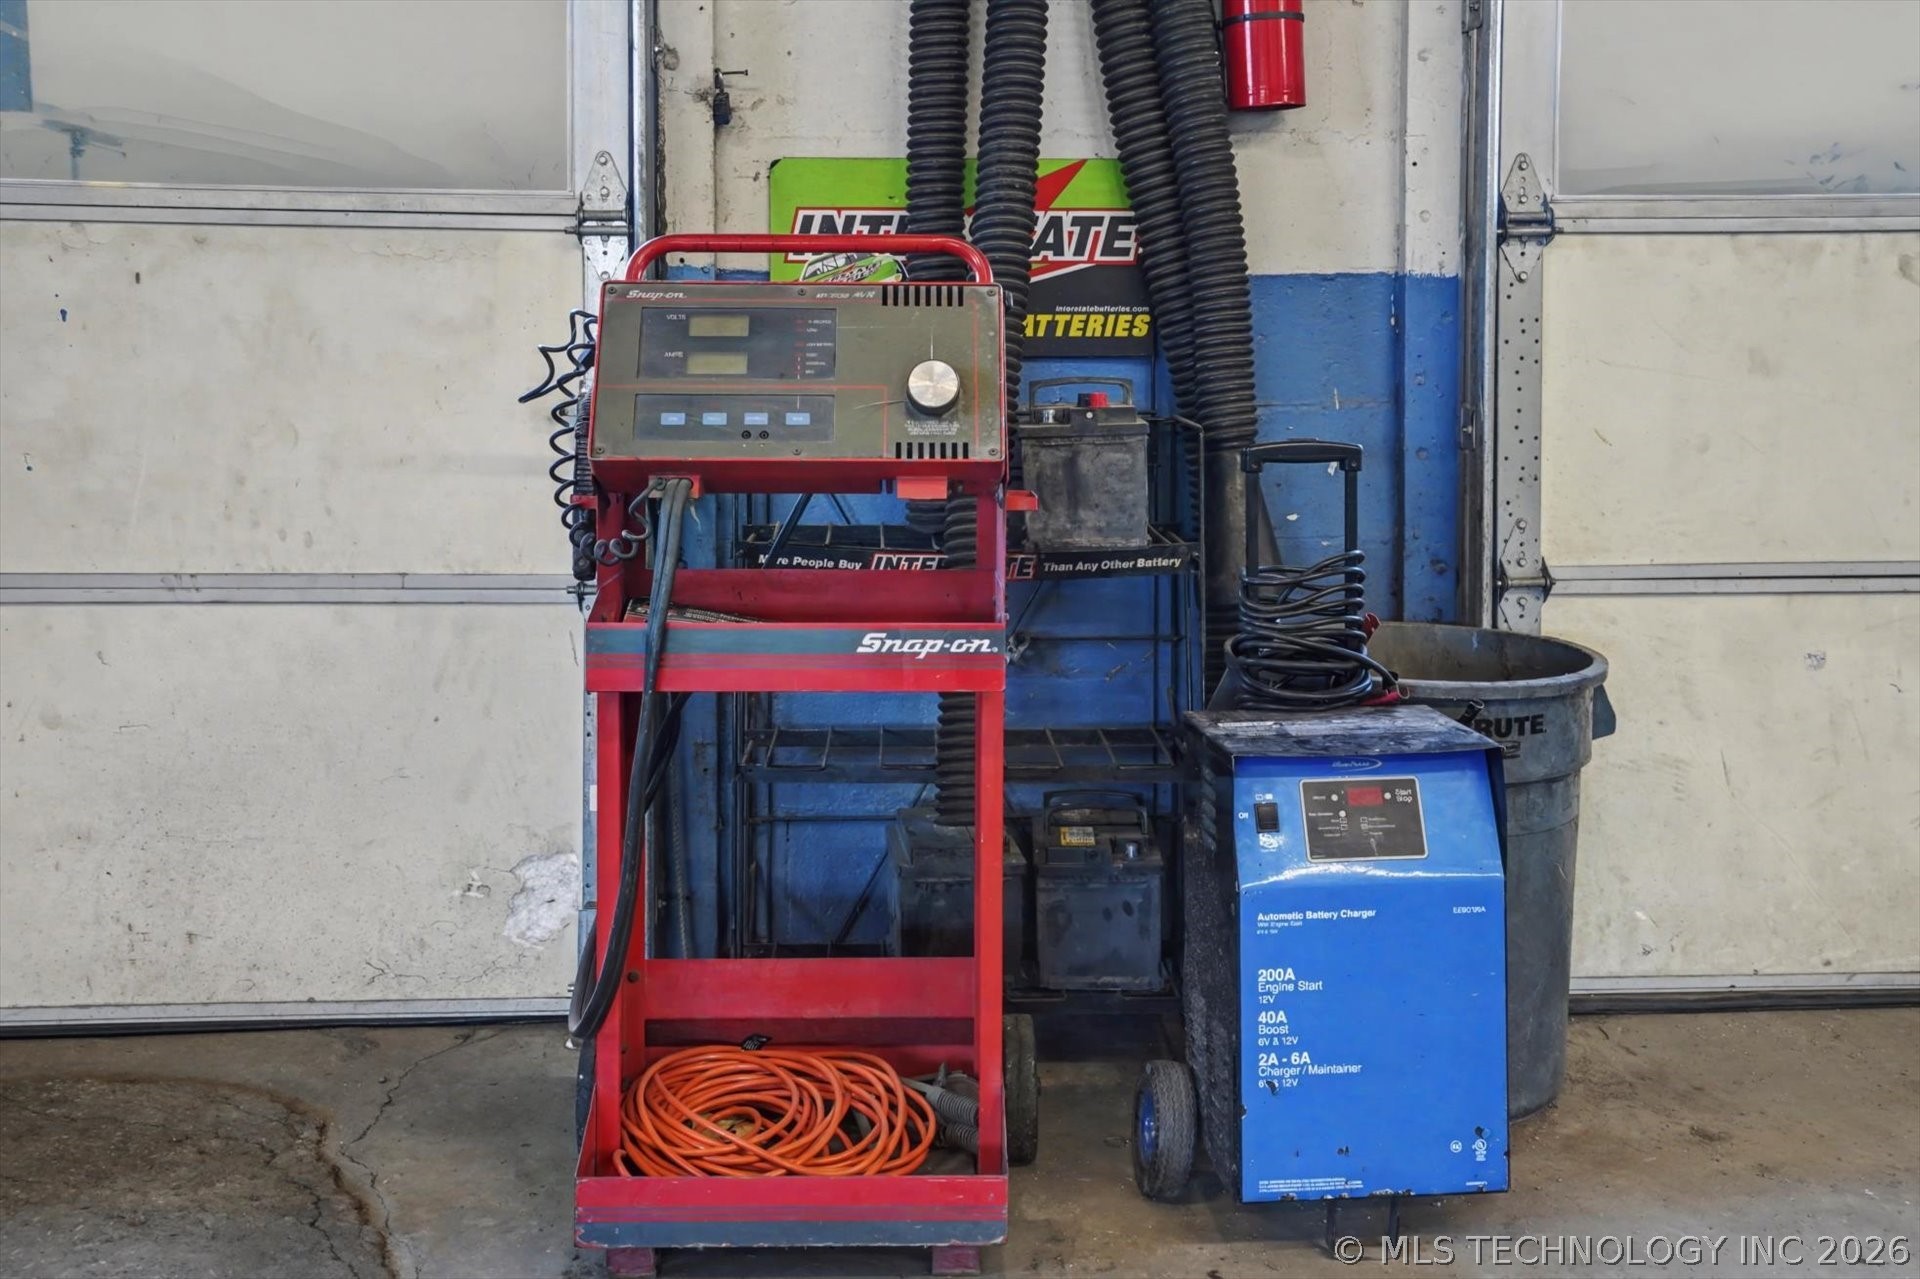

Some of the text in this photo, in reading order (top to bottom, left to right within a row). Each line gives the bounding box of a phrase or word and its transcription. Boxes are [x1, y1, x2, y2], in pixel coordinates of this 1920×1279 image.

[1021, 314, 1151, 337] ATTERIES
[758, 554, 789, 566] Mre
[793, 556, 835, 569] People
[838, 559, 862, 570] Buy
[1043, 562, 1074, 572] Than
[1075, 561, 1099, 572] Any
[1101, 560, 1134, 570] Other
[1136, 557, 1182, 568] Battery
[1473, 713, 1547, 738] RUTE
[1257, 909, 1376, 921] Automatic Battery Charger
[1258, 968, 1296, 981] 200A
[1258, 980, 1323, 994] Engine Start
[1258, 995, 1276, 1004] 12V
[1258, 1010, 1288, 1023] 40A
[1258, 1024, 1289, 1035] Boost
[1281, 1036, 1299, 1045] 12V
[1258, 1053, 1278, 1066] 2A
[1291, 1051, 1311, 1064] 6A
[1282, 1078, 1299, 1087] 12V
